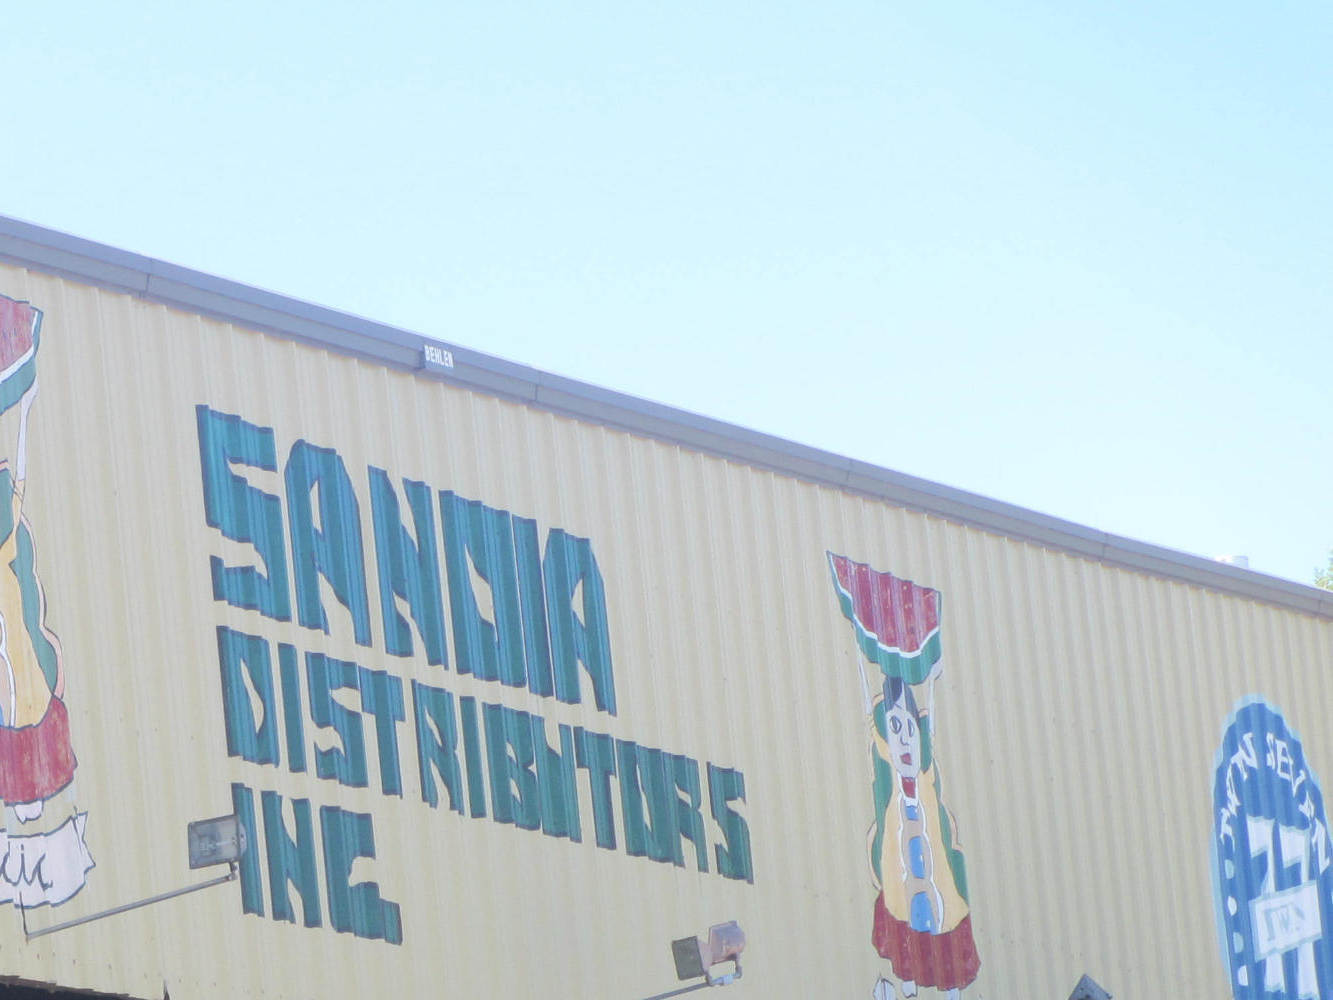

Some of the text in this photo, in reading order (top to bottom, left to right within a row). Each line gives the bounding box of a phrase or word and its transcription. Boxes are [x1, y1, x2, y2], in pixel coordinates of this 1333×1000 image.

[423, 344, 454, 369] BEHLEN
[195, 404, 617, 717] SANDIA
[216, 625, 754, 885] DISTRIBUTORS
[231, 782, 403, 946] INC
